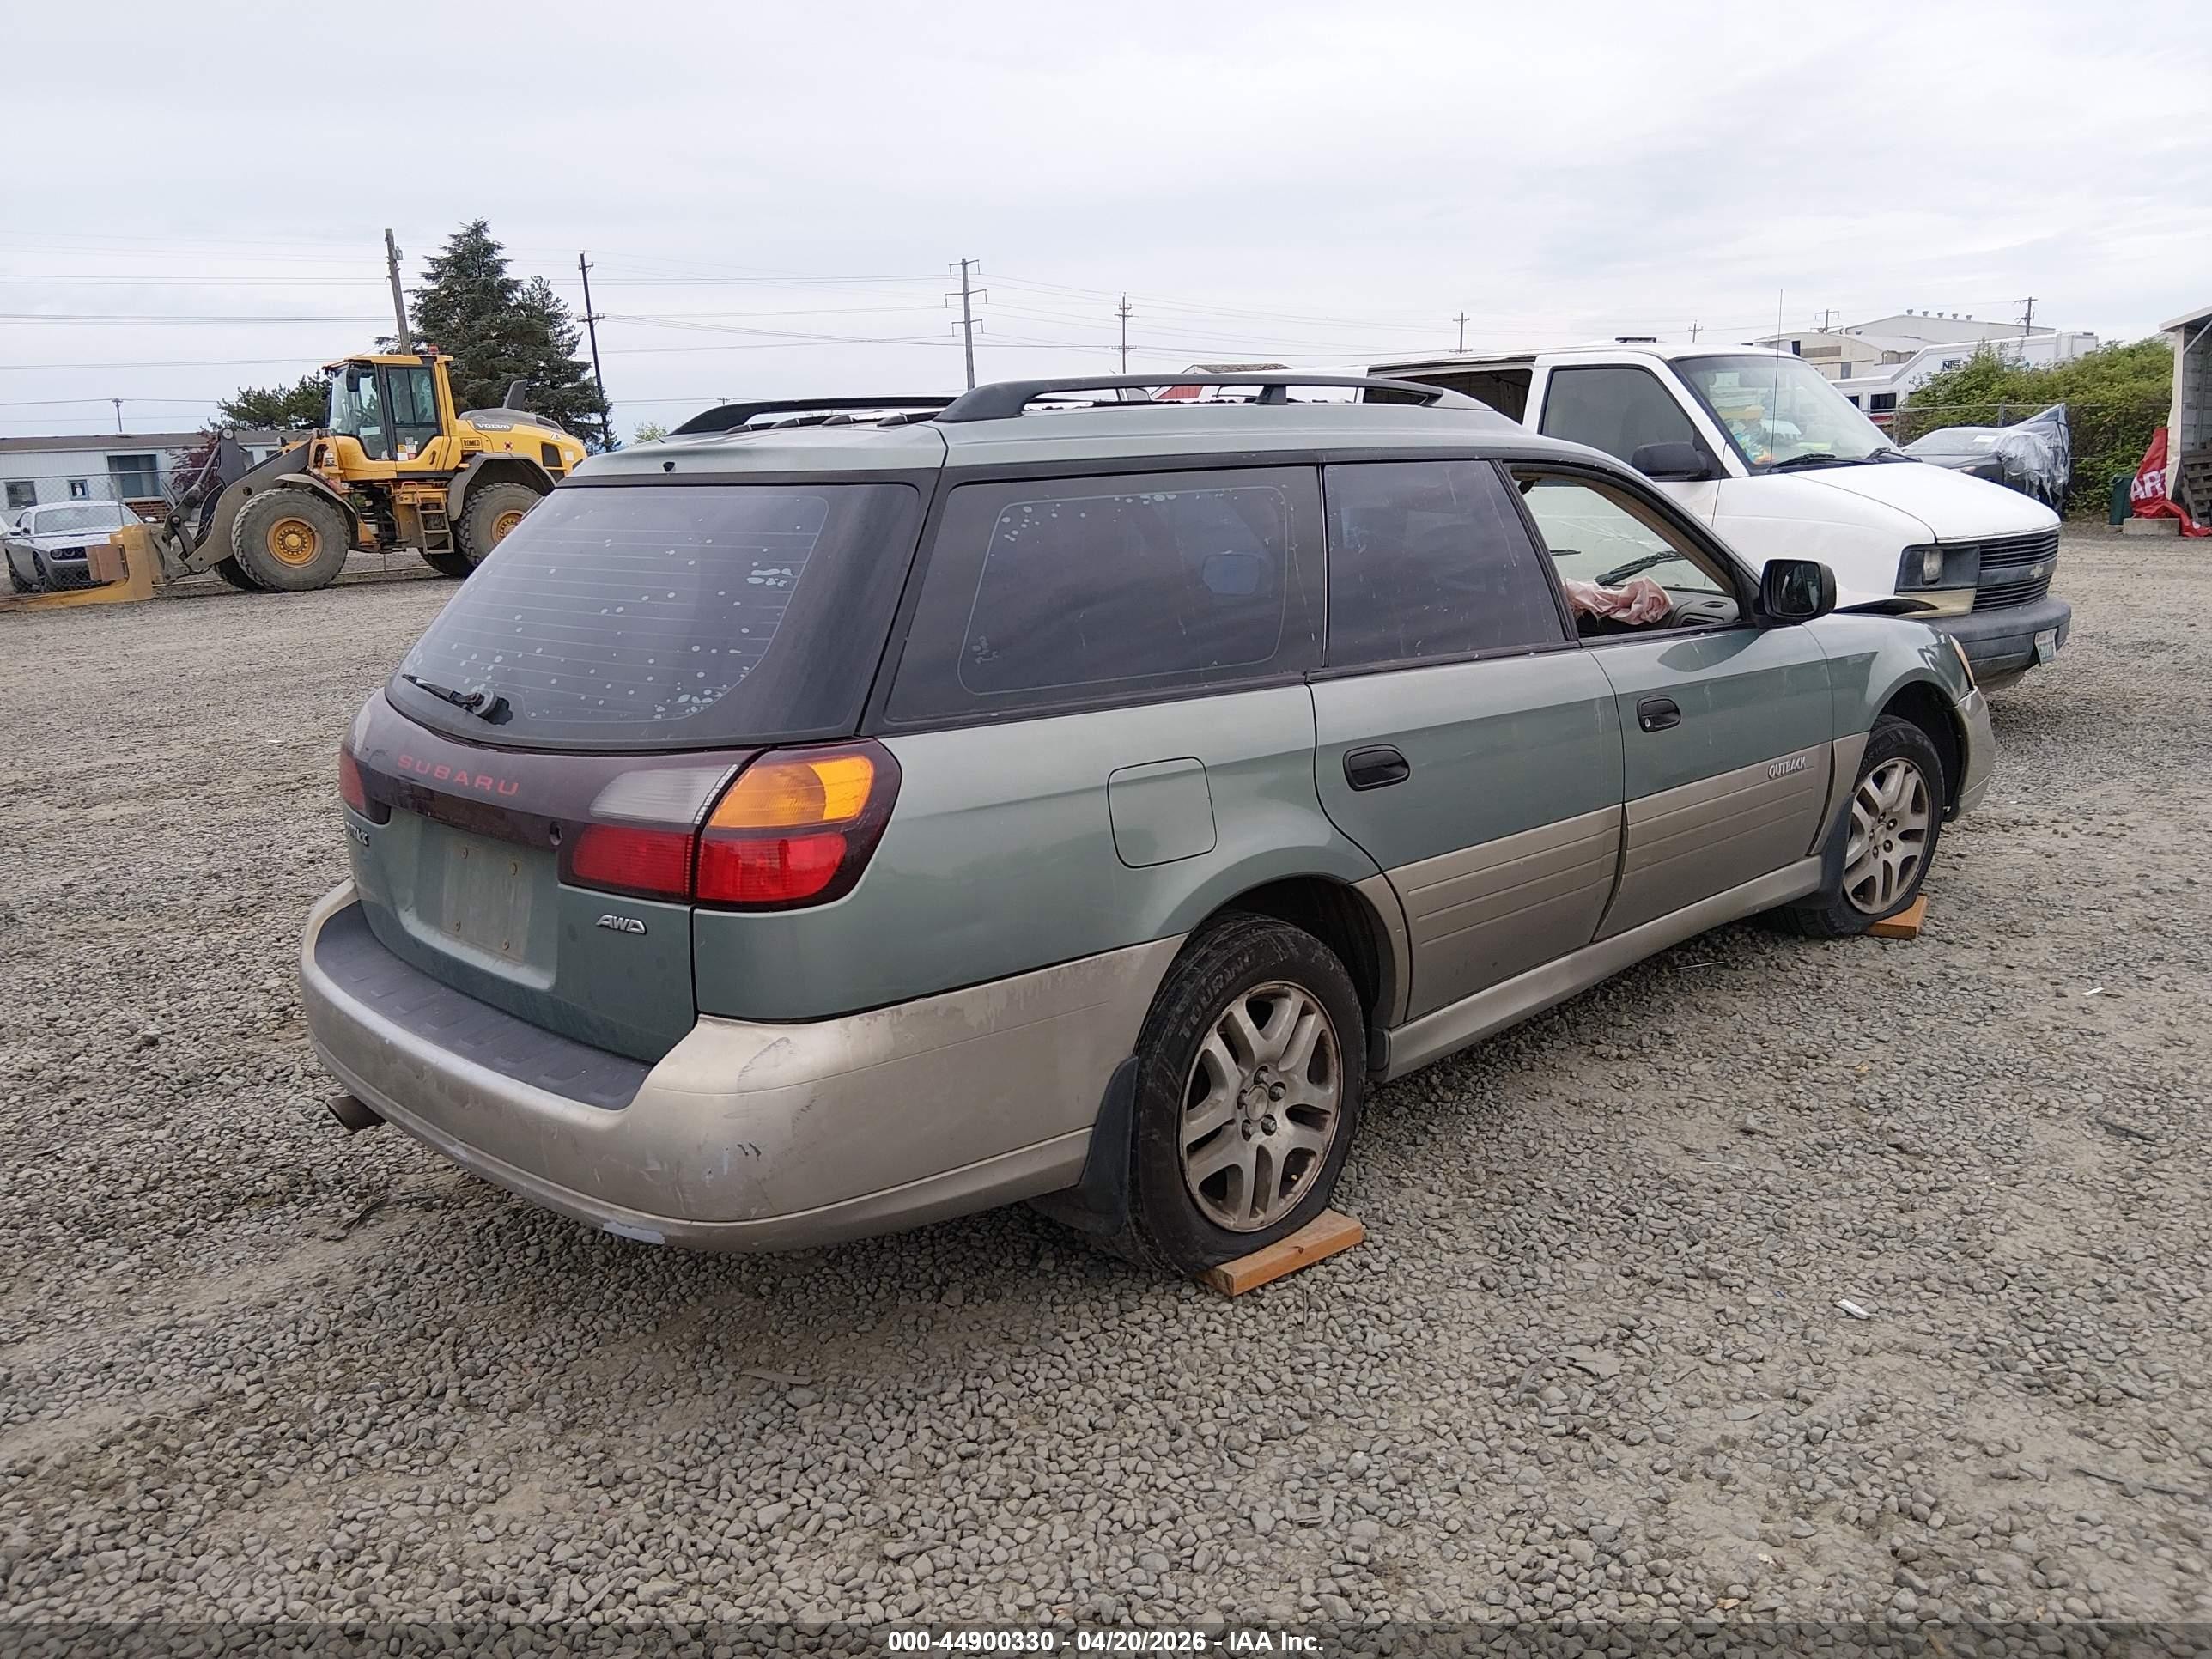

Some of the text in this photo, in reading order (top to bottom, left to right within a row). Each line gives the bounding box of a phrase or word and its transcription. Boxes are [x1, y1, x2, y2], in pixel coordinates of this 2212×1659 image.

[397, 754, 520, 797] SUBARU
[1768, 756, 1807, 779] OUTBACK
[596, 914, 647, 934] AWD
[1178, 950, 1254, 1040] TOURIN
